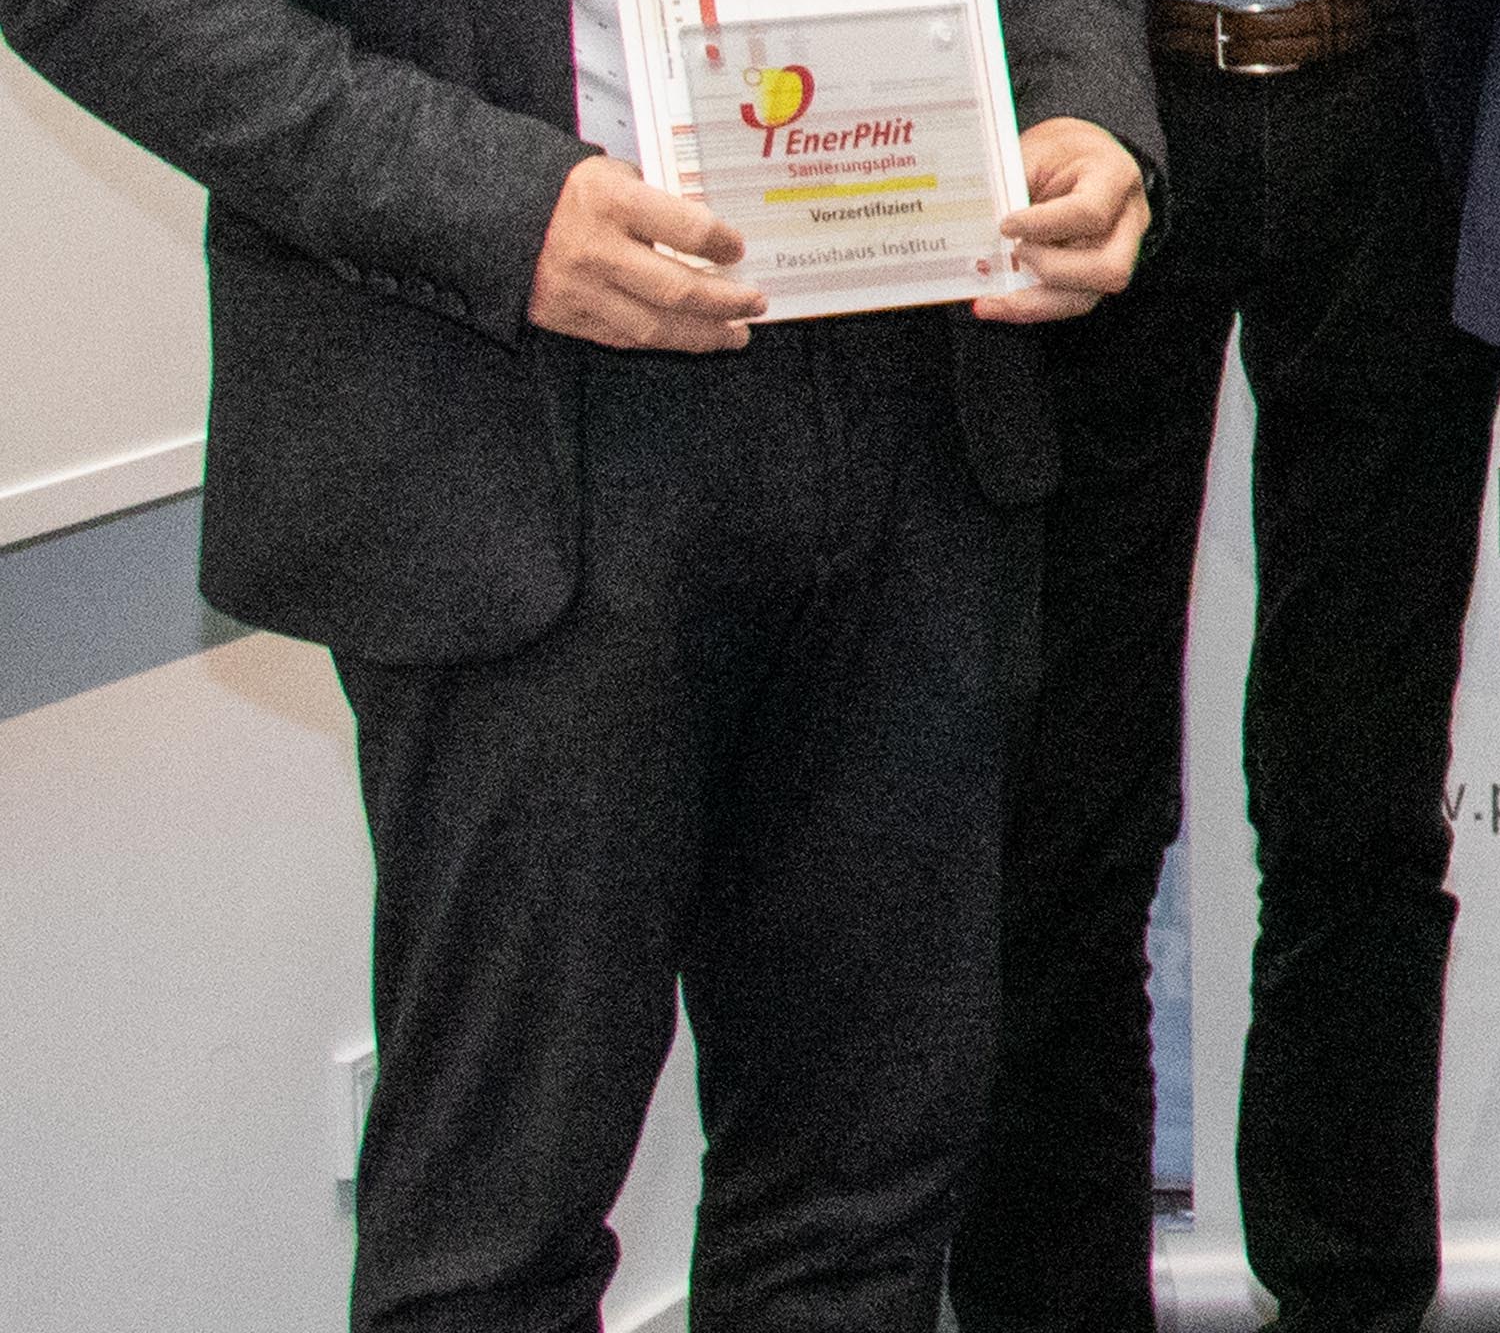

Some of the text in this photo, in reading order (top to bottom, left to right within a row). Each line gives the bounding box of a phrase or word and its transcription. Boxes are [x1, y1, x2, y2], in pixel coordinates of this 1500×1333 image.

[785, 117, 915, 156] EnerPHit
[786, 154, 917, 179] Sanierungsplan
[809, 198, 924, 224] Vorzertifiziert
[775, 236, 949, 269] Passivhaus Institut
